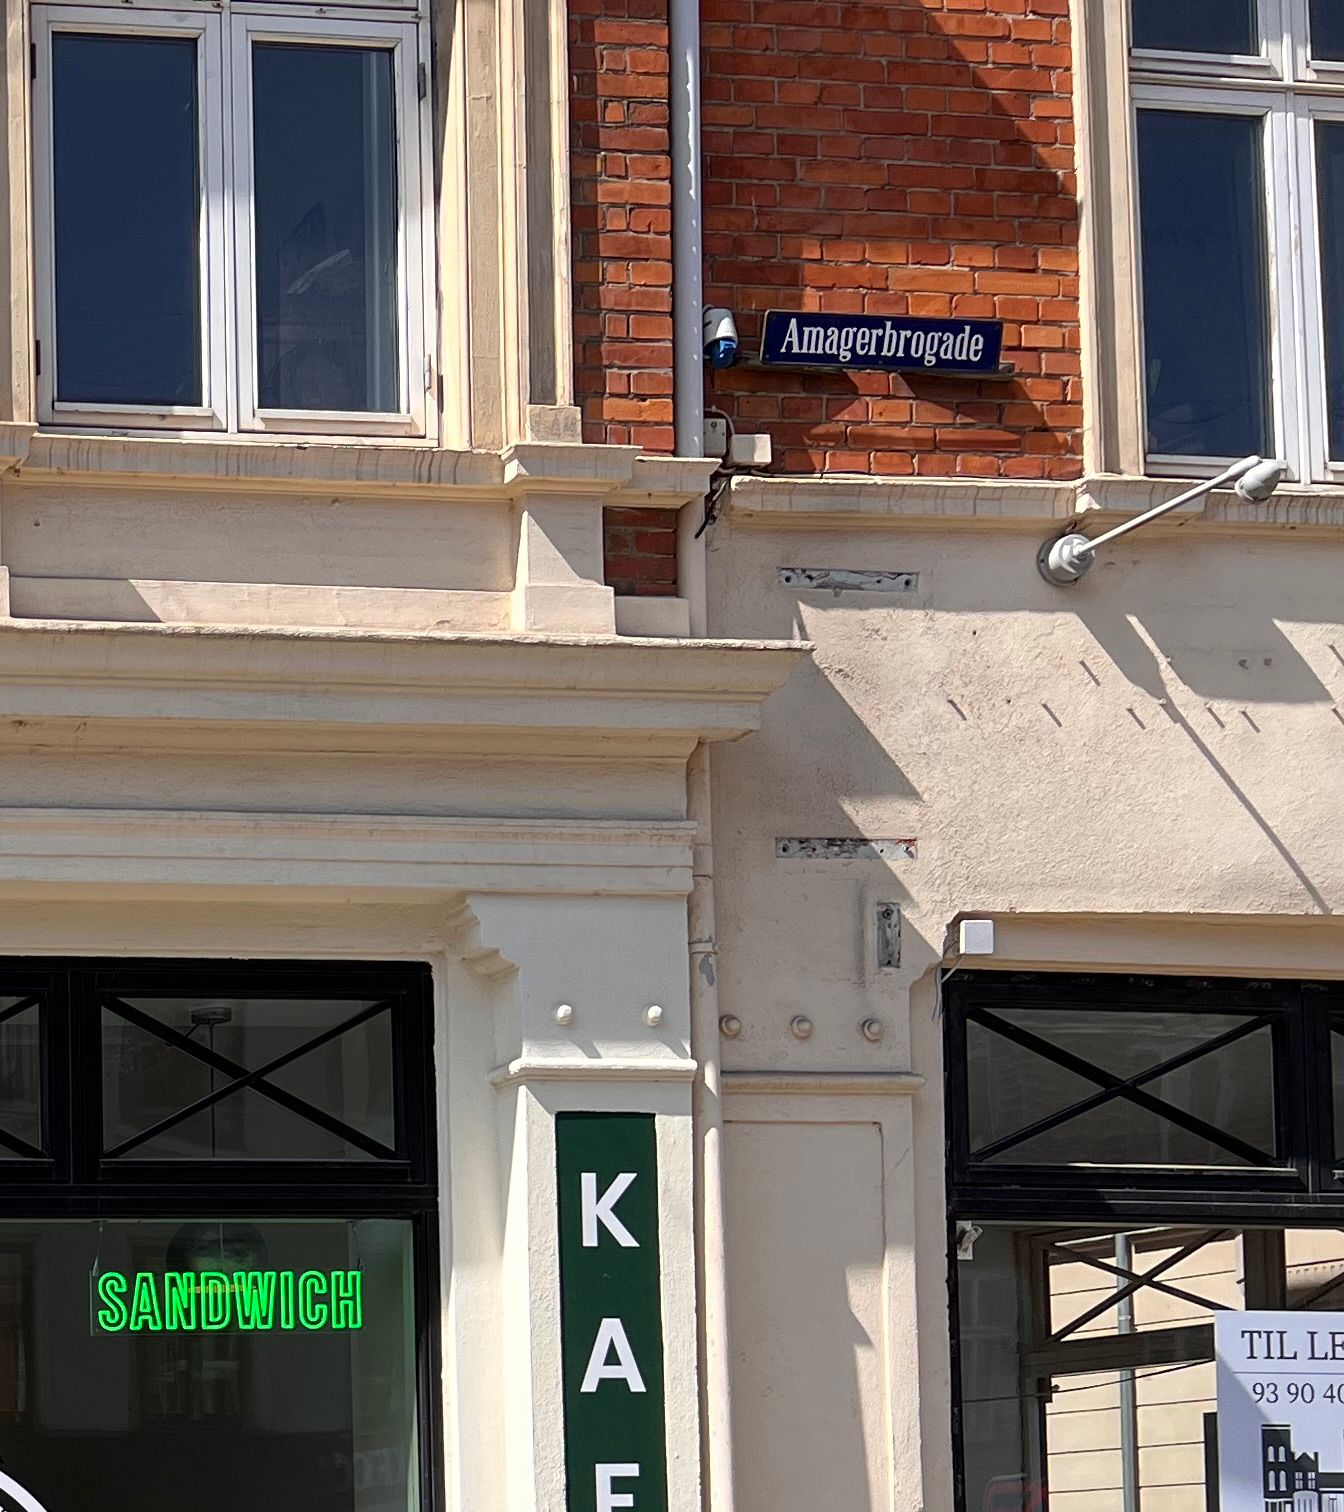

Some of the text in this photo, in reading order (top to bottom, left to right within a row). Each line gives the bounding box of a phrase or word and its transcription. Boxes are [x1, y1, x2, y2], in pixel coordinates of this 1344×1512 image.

[781, 317, 984, 367] Amagerbrogade
[97, 1269, 363, 1333] SANDWICH
[1241, 1330, 1344, 1361] TIL LE
[1252, 1382, 1279, 1404] 93
[1287, 1382, 1315, 1404] 90
